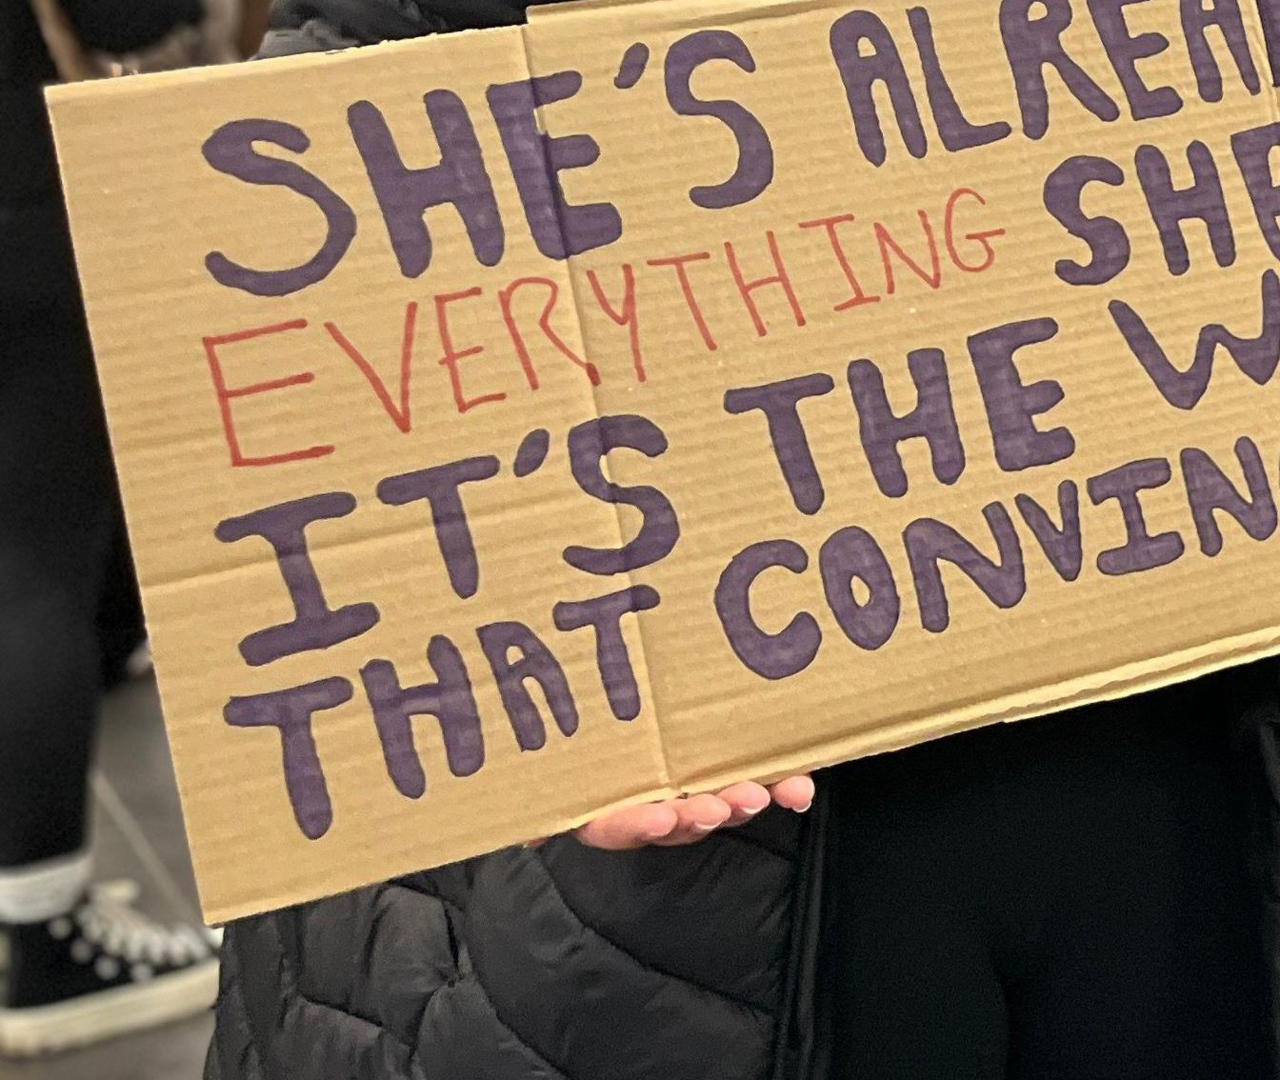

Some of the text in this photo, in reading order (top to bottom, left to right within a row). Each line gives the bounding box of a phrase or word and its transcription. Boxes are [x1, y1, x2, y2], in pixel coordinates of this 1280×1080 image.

[202, 30, 774, 296] SHE'S
[202, 189, 1005, 467] EVERYTHING
[214, 415, 681, 668] IT'S
[724, 317, 1076, 517] THE
[223, 584, 660, 841] THAT
